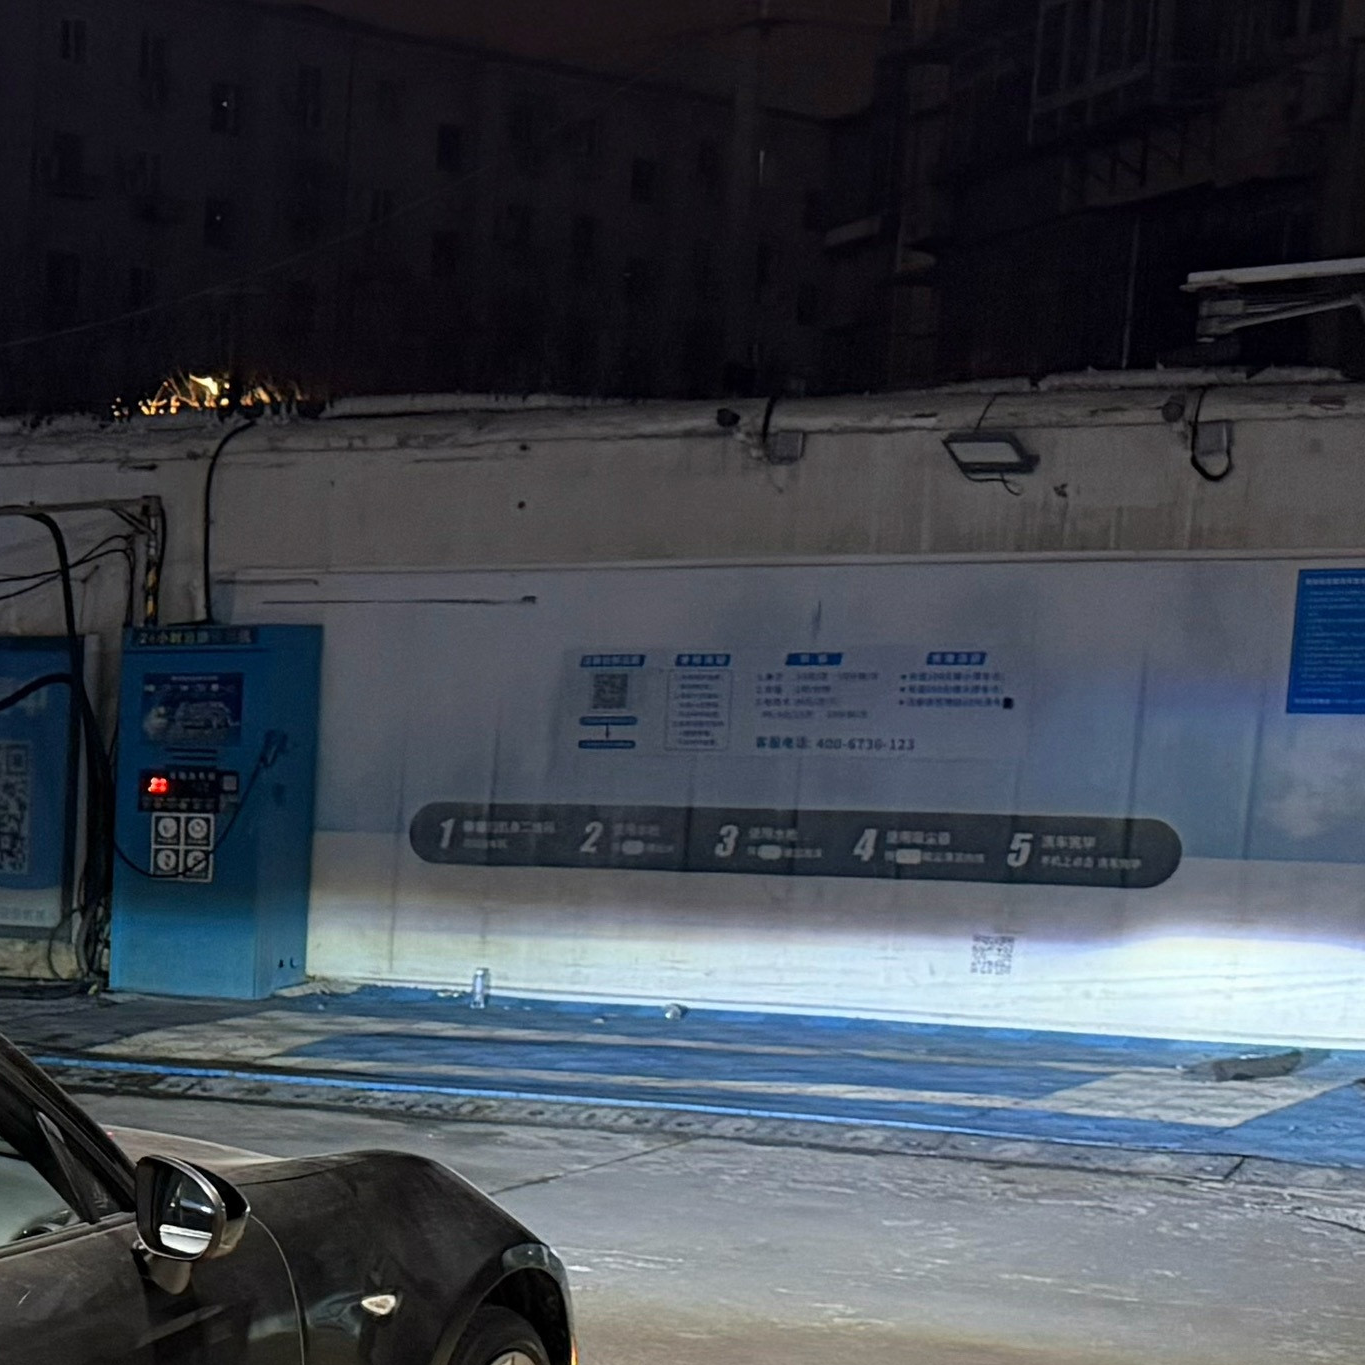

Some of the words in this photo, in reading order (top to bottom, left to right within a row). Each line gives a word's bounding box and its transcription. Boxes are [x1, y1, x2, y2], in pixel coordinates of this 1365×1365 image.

[439, 819, 456, 849] 1
[580, 821, 604, 854] 2
[714, 825, 740, 858] 3
[853, 828, 878, 862] 4
[1007, 833, 1034, 868] 5
